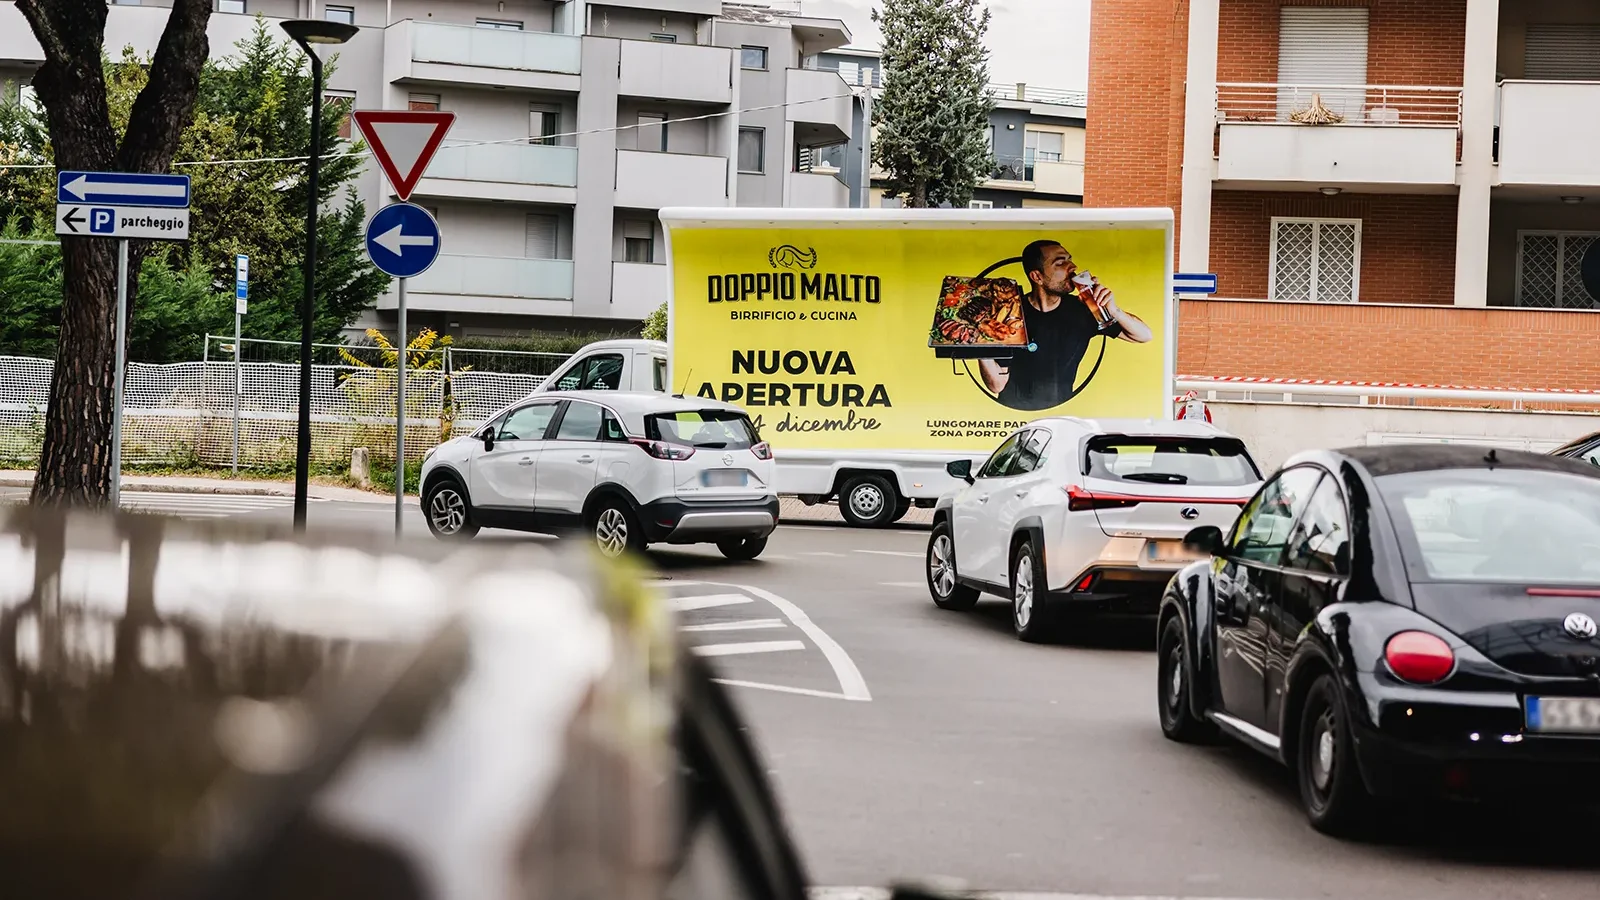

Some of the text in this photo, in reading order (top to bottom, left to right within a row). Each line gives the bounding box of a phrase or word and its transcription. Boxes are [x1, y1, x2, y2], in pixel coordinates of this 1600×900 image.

[95, 211, 184, 231] P parcheggio
[707, 272, 881, 304] DOPPIO MALTO
[730, 311, 796, 320] BIRRIFICIO
[810, 311, 857, 321] CUCINA
[731, 350, 856, 375] NUOVA
[696, 382, 892, 408] APERTURA
[776, 409, 882, 432] dicembre
[926, 420, 1001, 428] LUNGOMARE
